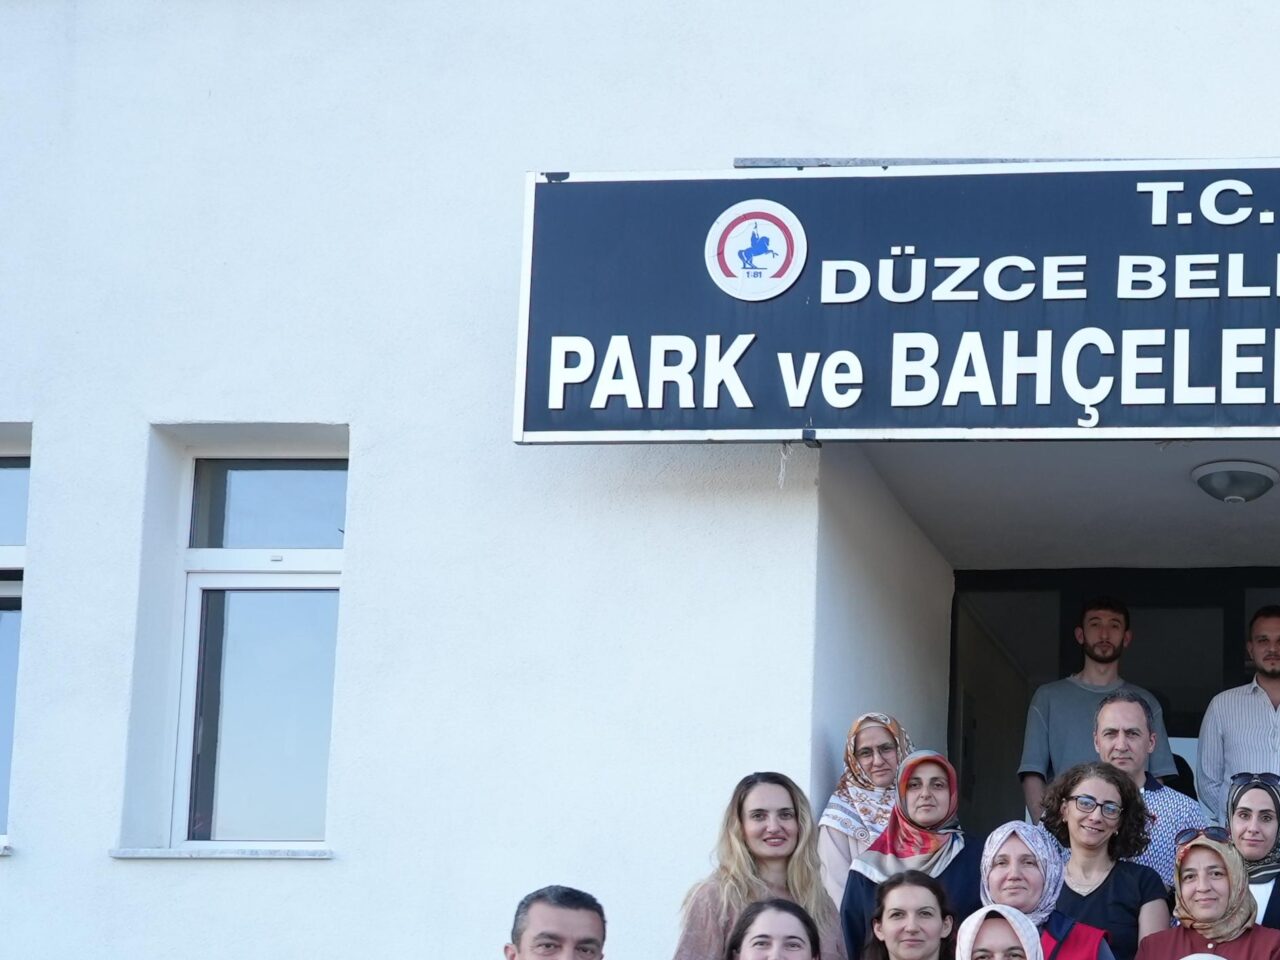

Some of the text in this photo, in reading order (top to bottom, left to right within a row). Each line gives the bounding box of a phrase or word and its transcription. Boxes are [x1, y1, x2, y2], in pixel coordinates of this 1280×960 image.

[1136, 179, 1275, 225] T.C.
[820, 246, 1087, 303] DÜZCE
[548, 333, 757, 409] PARK
[777, 351, 863, 409] ve
